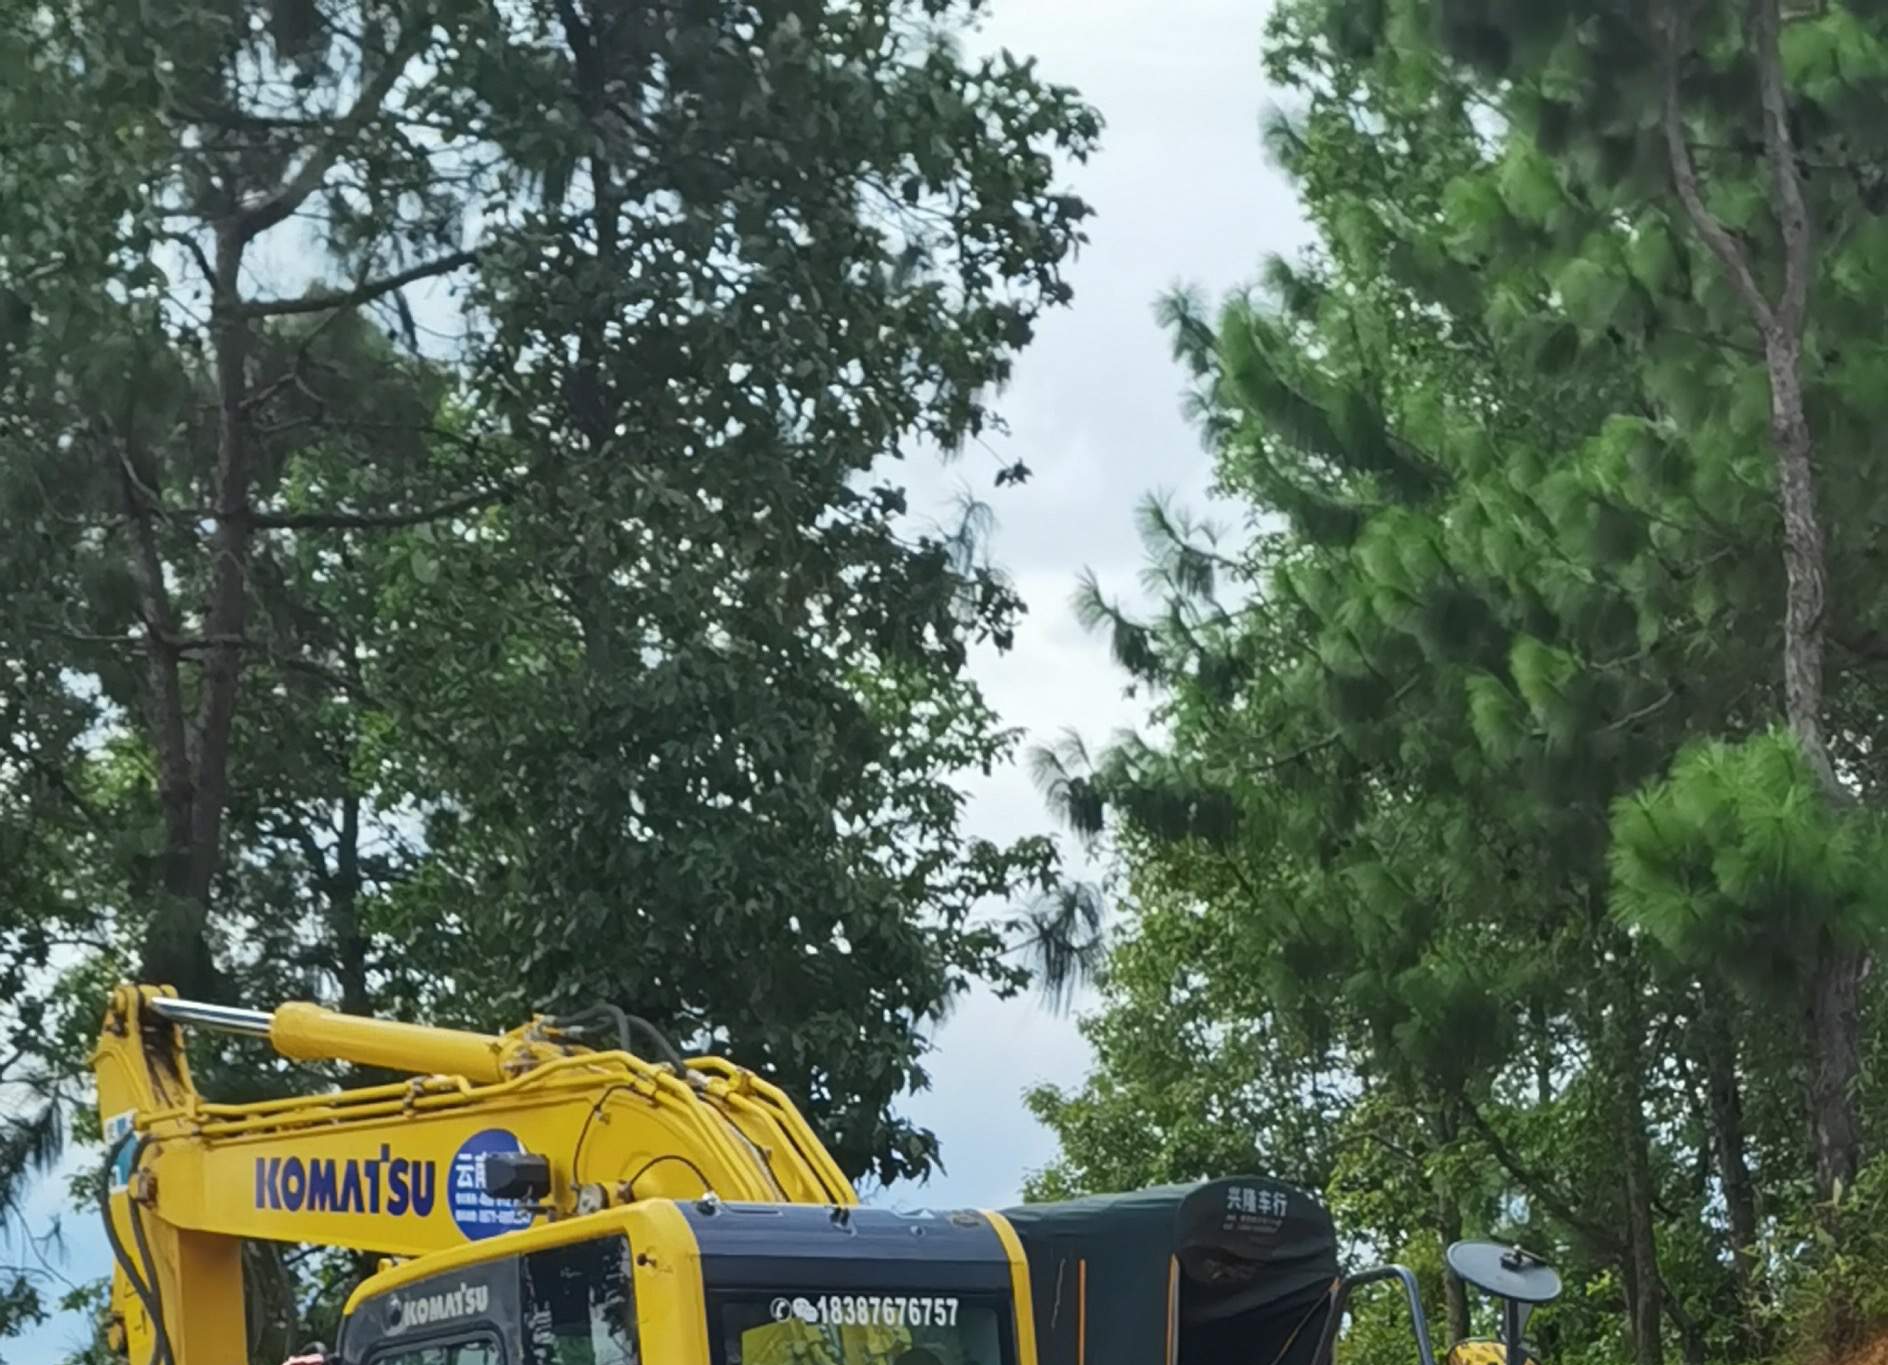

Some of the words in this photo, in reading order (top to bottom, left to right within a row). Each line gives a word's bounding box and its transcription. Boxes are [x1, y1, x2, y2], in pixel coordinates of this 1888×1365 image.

[256, 1143, 435, 1217] KOMATSU
[402, 1282, 488, 1326] KOMATSU
[817, 1296, 958, 1326] 18387676757
